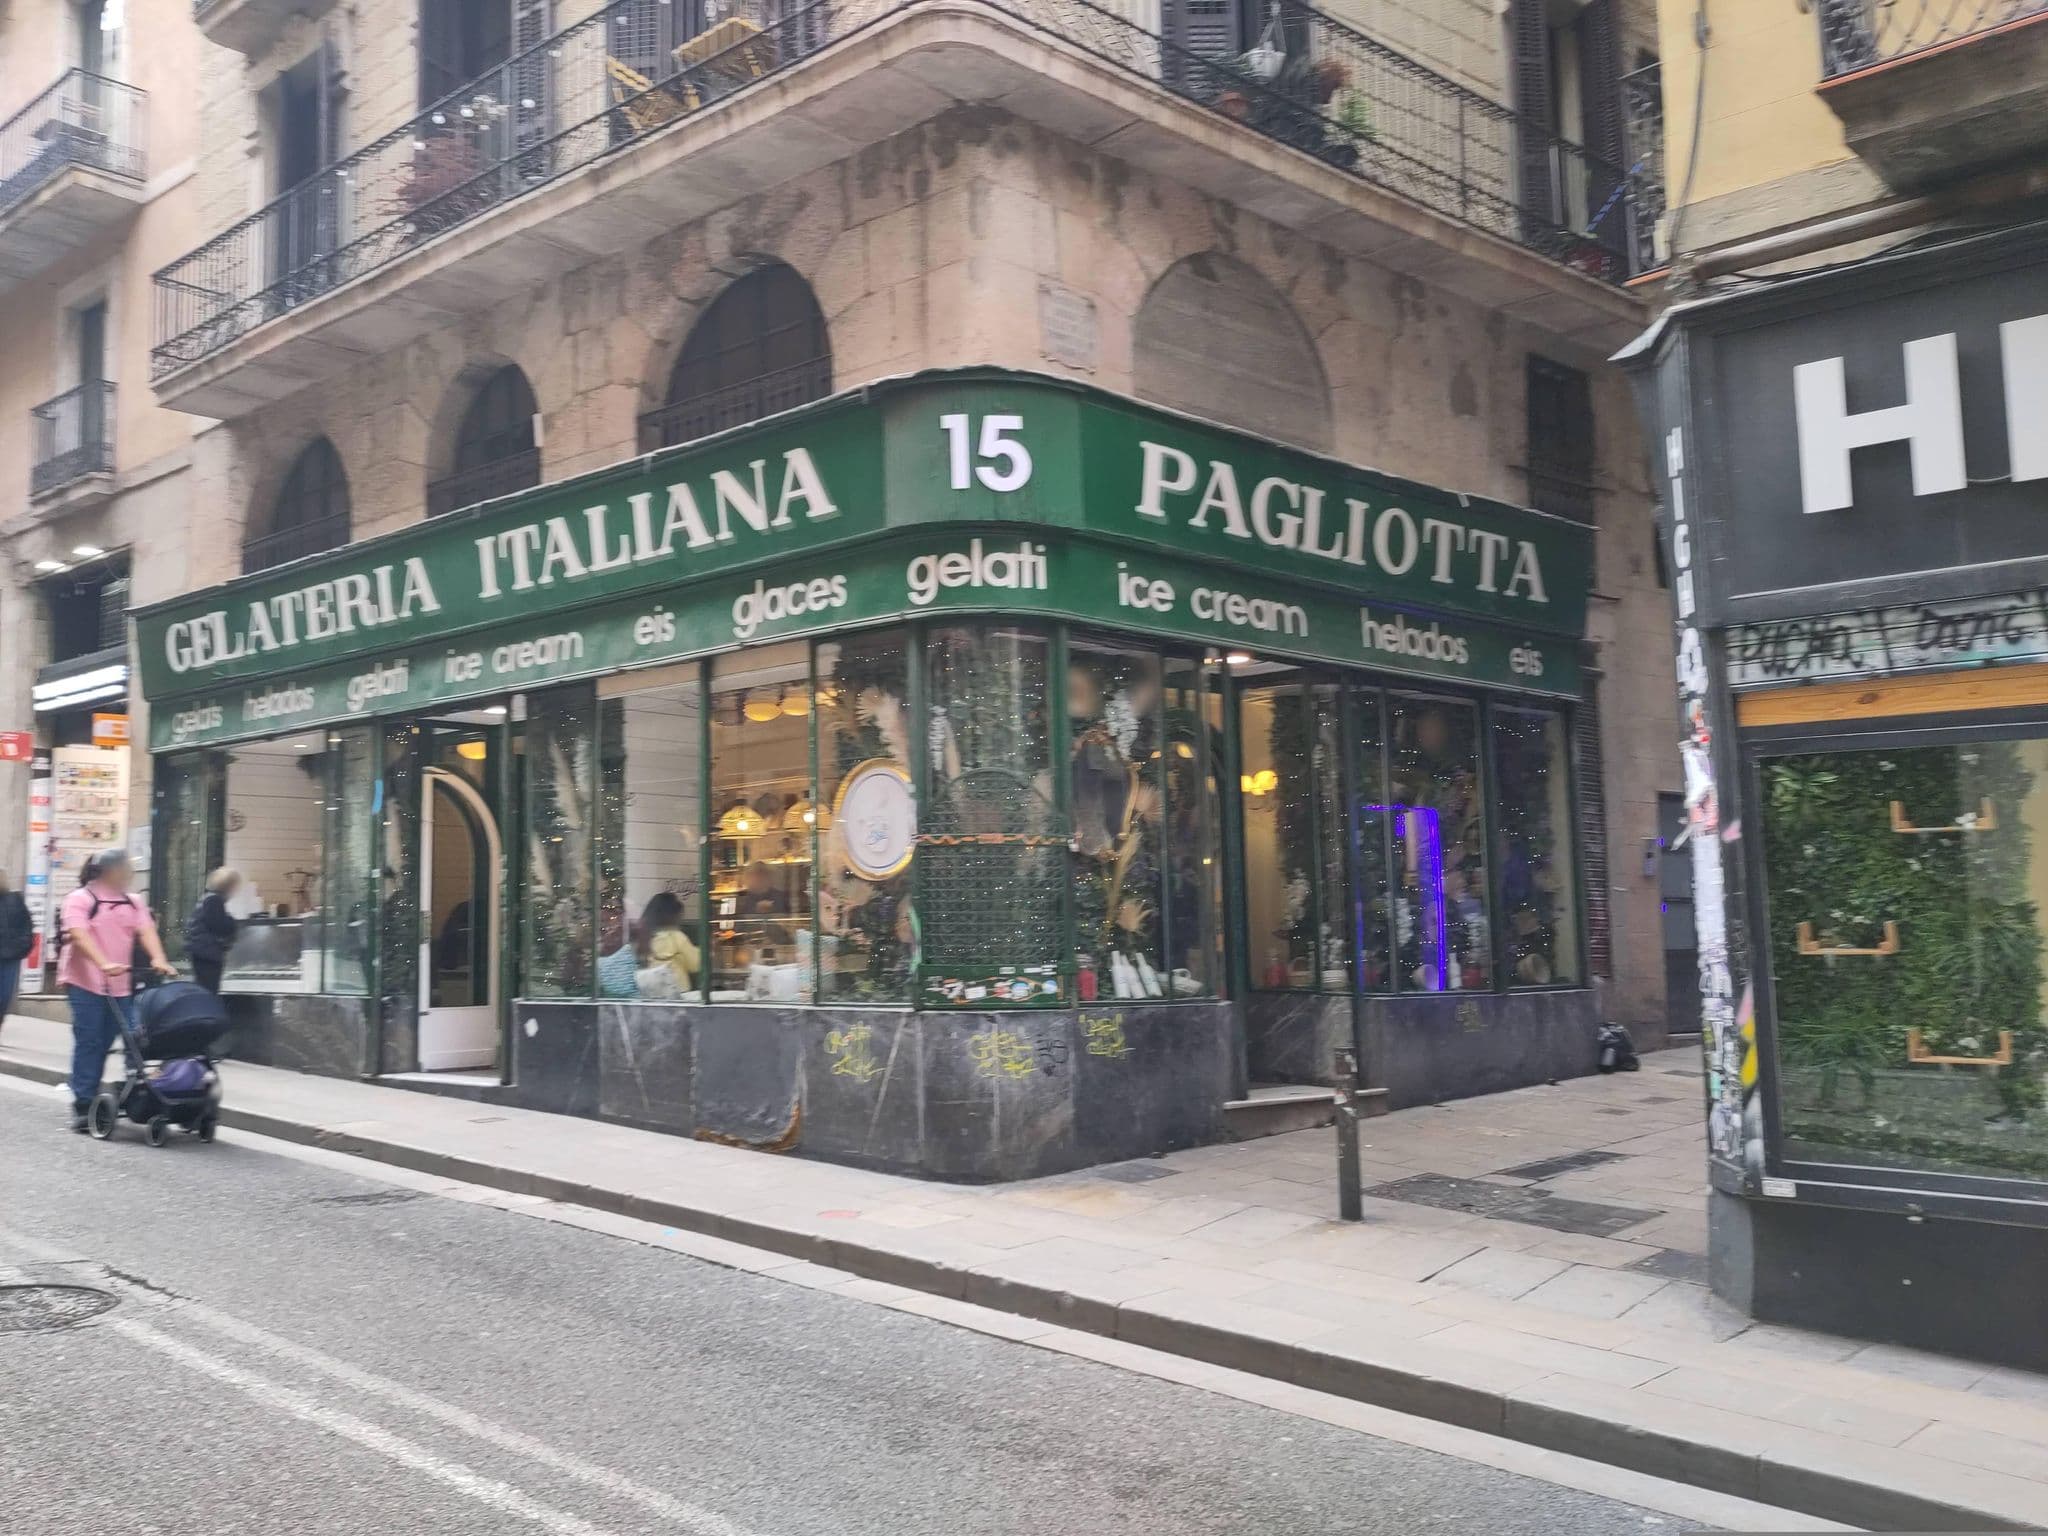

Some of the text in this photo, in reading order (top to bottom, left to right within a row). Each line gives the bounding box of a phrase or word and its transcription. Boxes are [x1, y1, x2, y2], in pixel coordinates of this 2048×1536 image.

[939, 413, 1033, 491] 15
[165, 447, 838, 673] GELATERIA ITALIANA
[907, 538, 1048, 605] gelati
[1134, 440, 1549, 602] PAGLIOTTA
[346, 658, 409, 712] gelati
[444, 649, 482, 683] ice
[492, 631, 583, 673] cream
[633, 605, 676, 646] eis
[732, 574, 848, 638] glaces
[1117, 562, 1544, 676] ice cream helados eis
